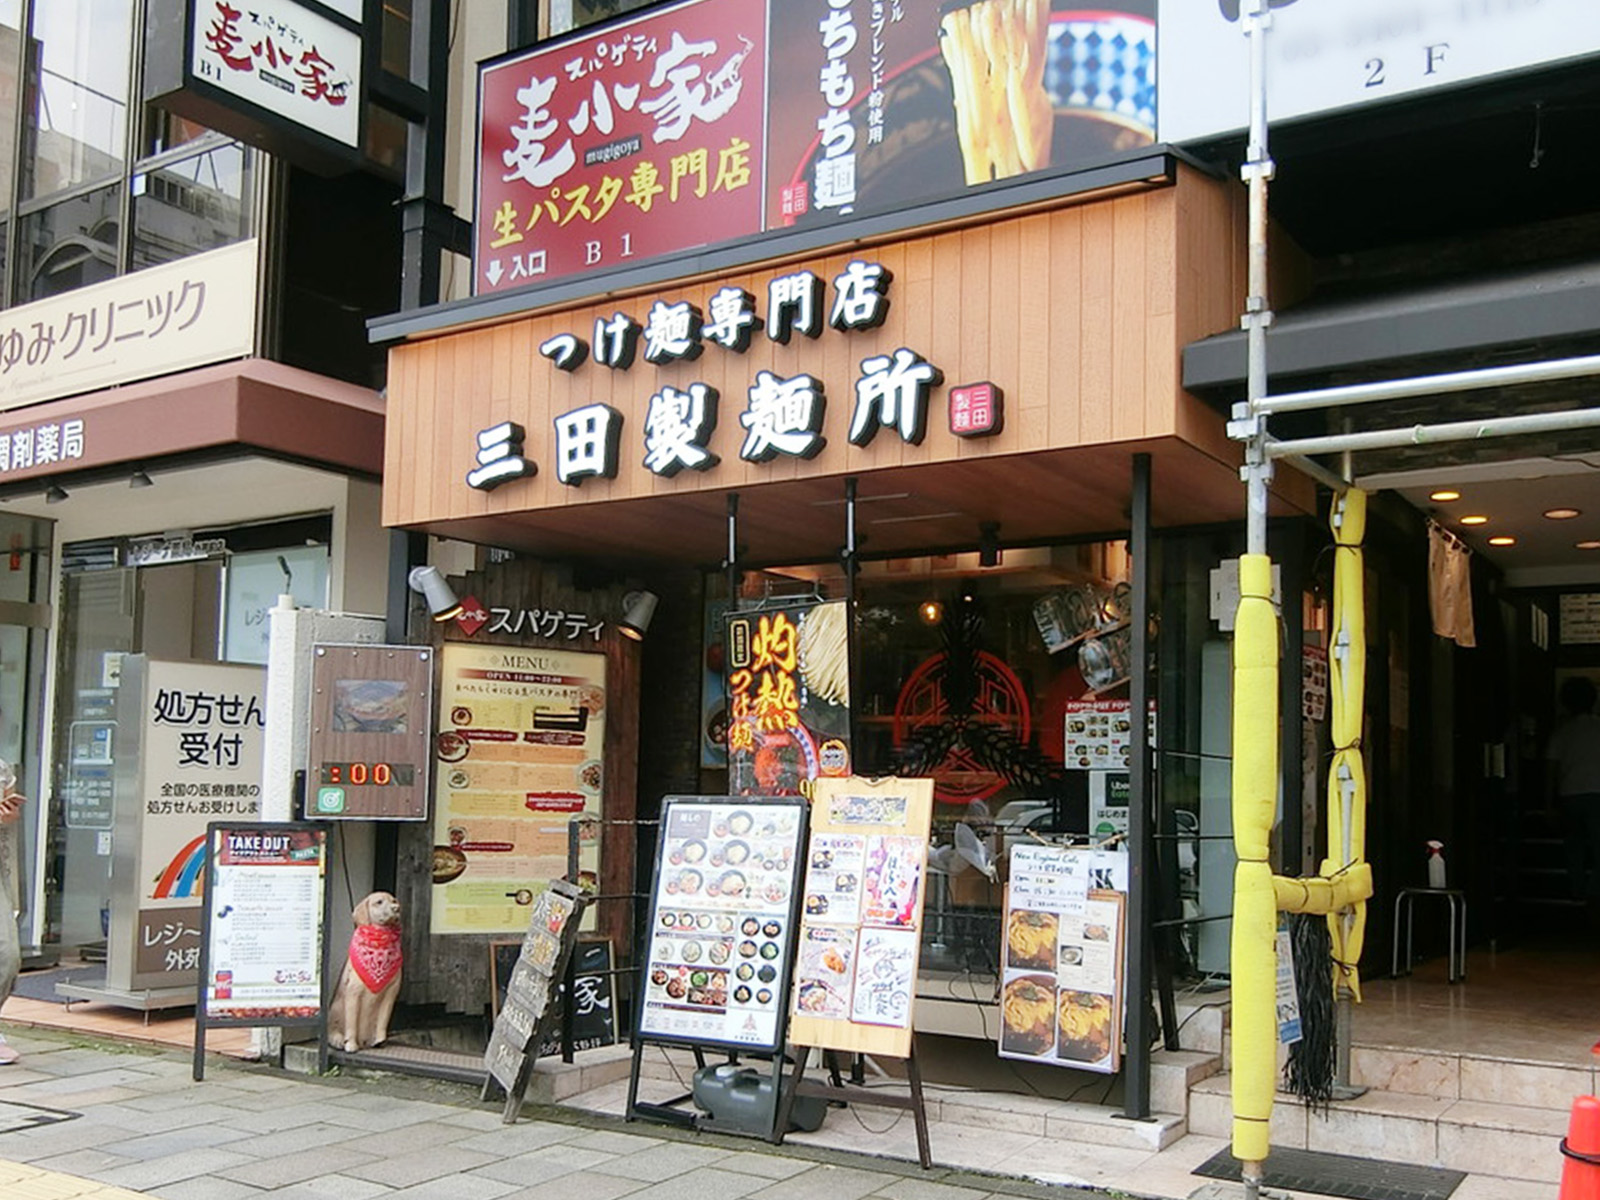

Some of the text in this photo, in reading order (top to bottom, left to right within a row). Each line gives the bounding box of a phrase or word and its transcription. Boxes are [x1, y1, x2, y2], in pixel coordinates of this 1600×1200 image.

[564, 34, 659, 82] スパゲティ
[585, 139, 640, 163] mugigoya
[489, 137, 751, 249] 生パスタ専門店
[510, 251, 547, 280] 入口
[0, 280, 206, 374] ゆみクリニック
[541, 260, 888, 370] つけ麺専門店
[467, 348, 938, 489] 三田製麺所
[488, 608, 605, 641] スパゲティ
[502, 655, 549, 670] MENU
[752, 612, 799, 731] 灼熱
[154, 688, 266, 725] 処方せん
[180, 732, 243, 767] 受付
[161, 782, 260, 798] 全国の医療機関の
[228, 836, 290, 850] TAKE OUT
